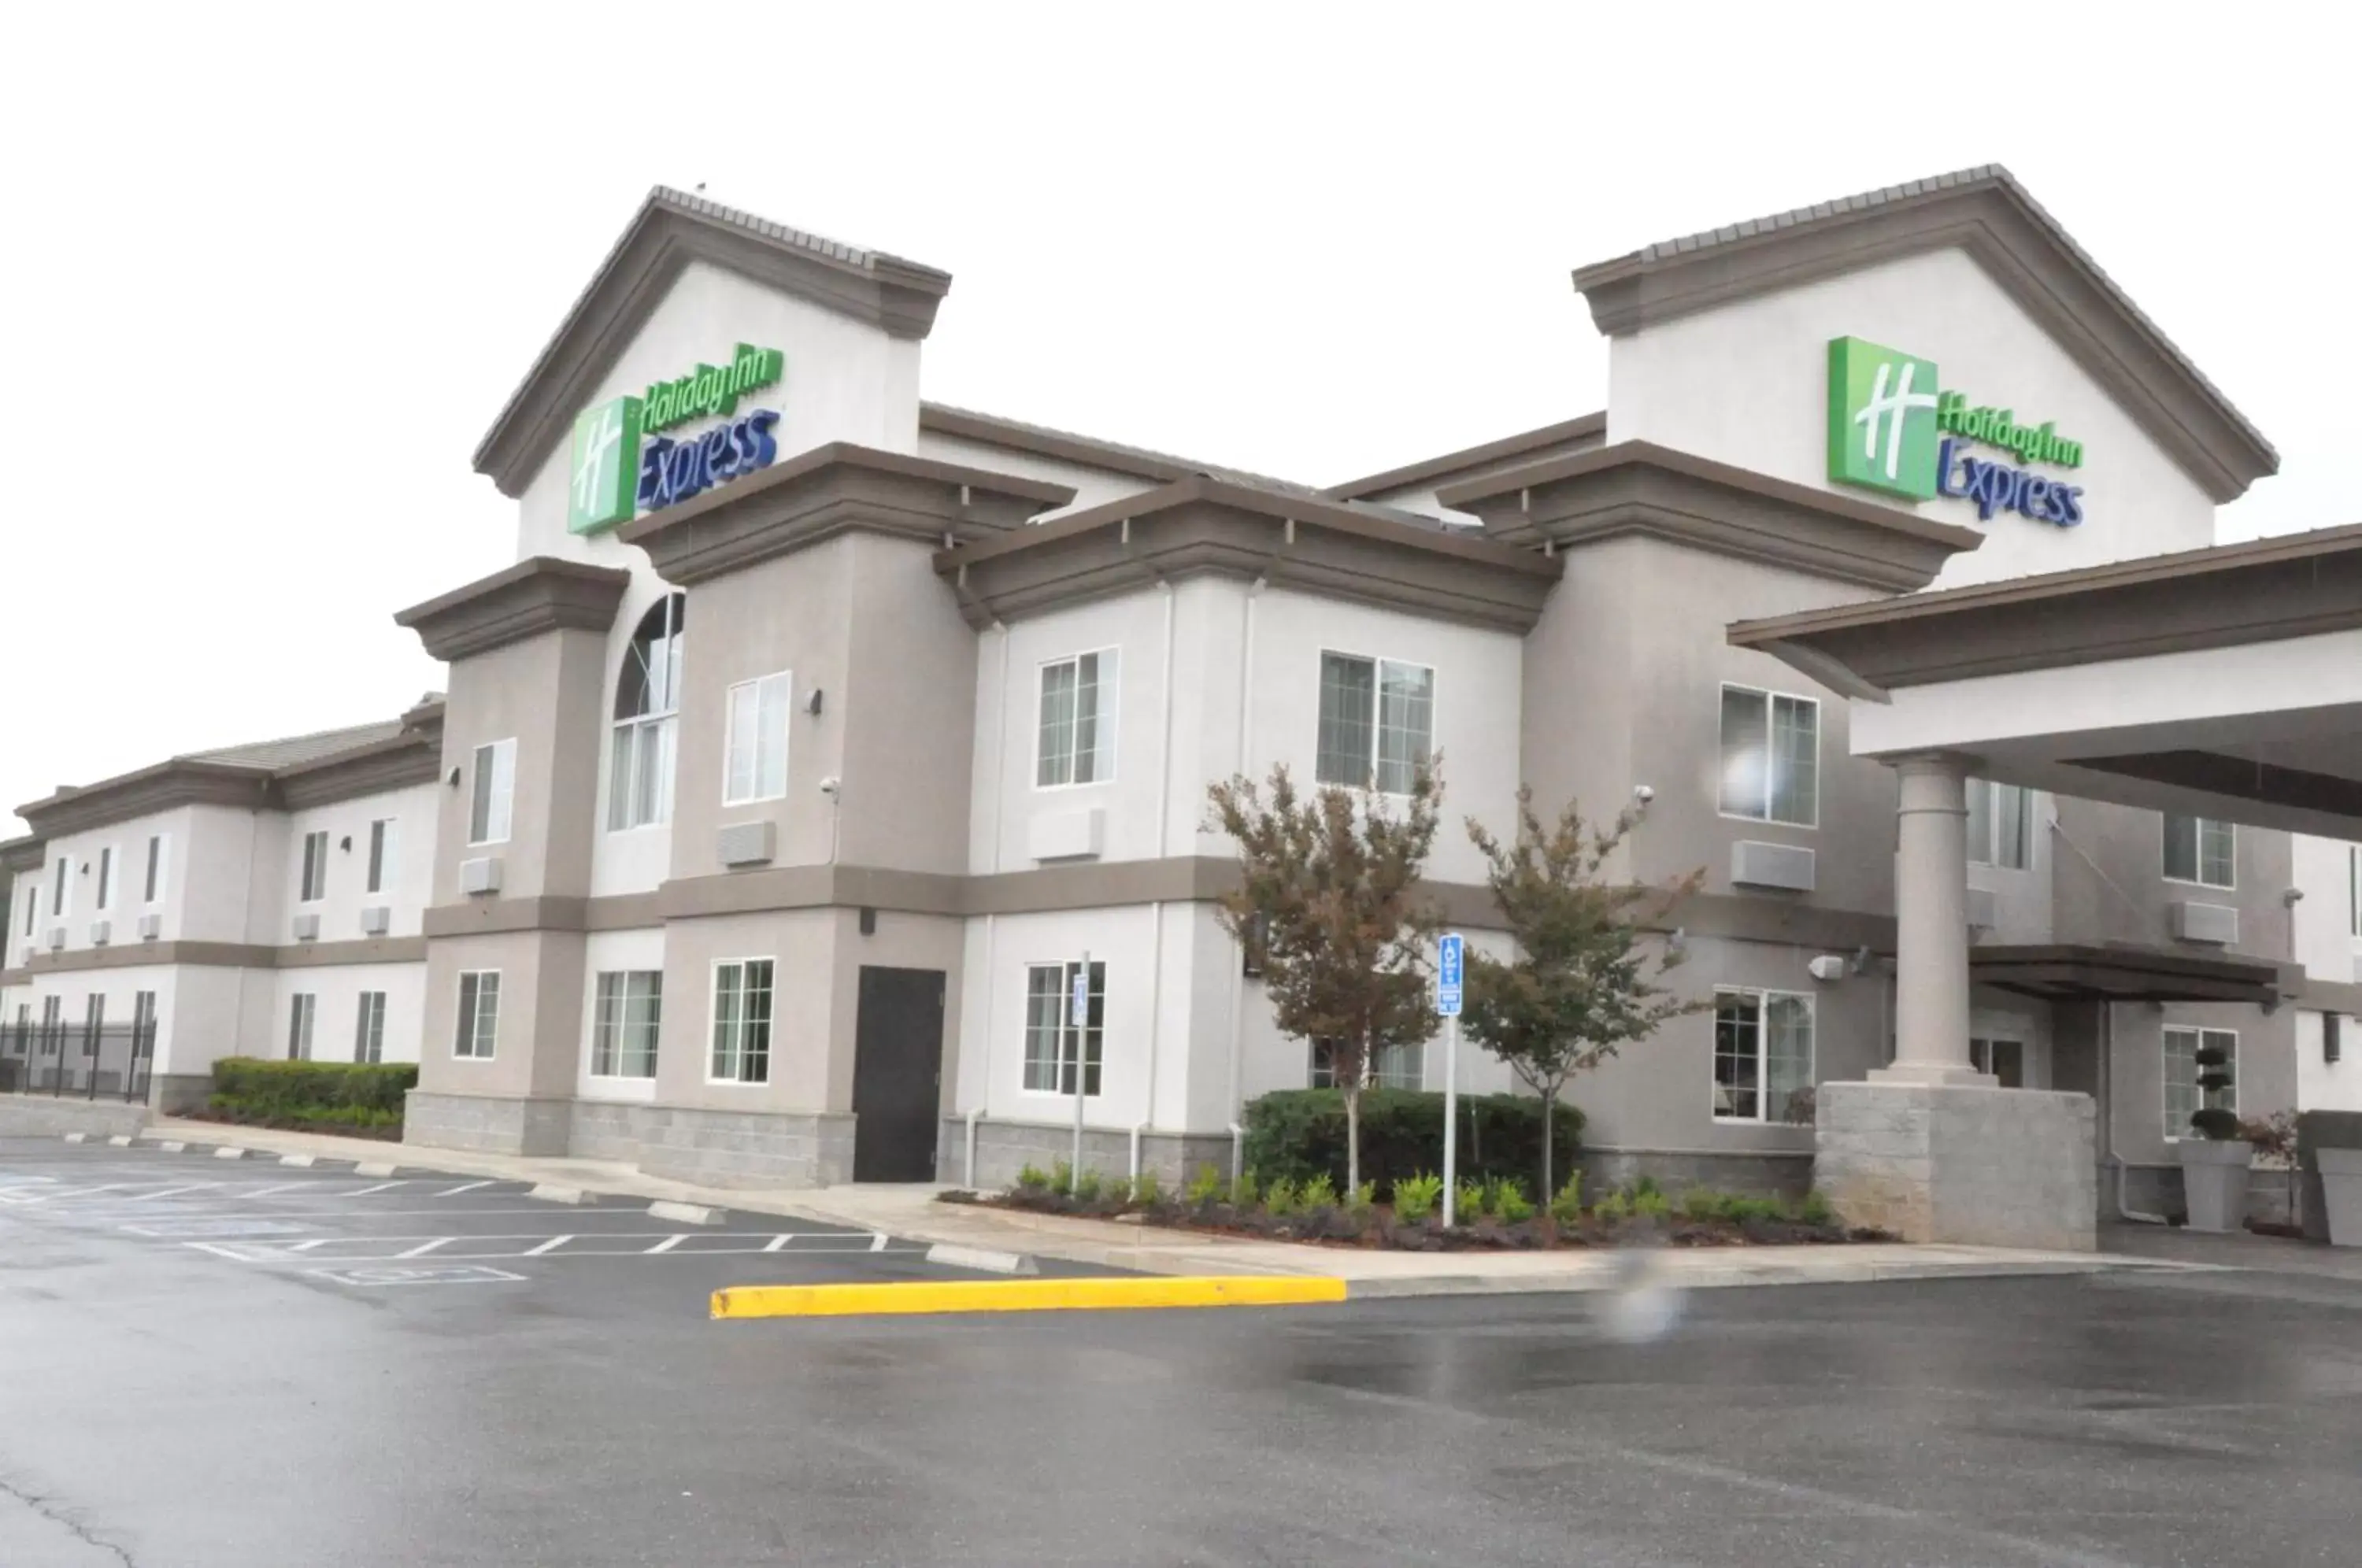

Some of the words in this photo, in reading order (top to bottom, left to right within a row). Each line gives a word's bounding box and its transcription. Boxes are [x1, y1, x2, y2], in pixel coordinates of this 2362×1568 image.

[640, 363, 735, 435] Holiday
[729, 342, 783, 394] Inn
[1938, 390, 2043, 464] Holiday
[2042, 422, 2083, 468] Inn
[636, 408, 780, 511] Express
[1938, 437, 2084, 527] Express
